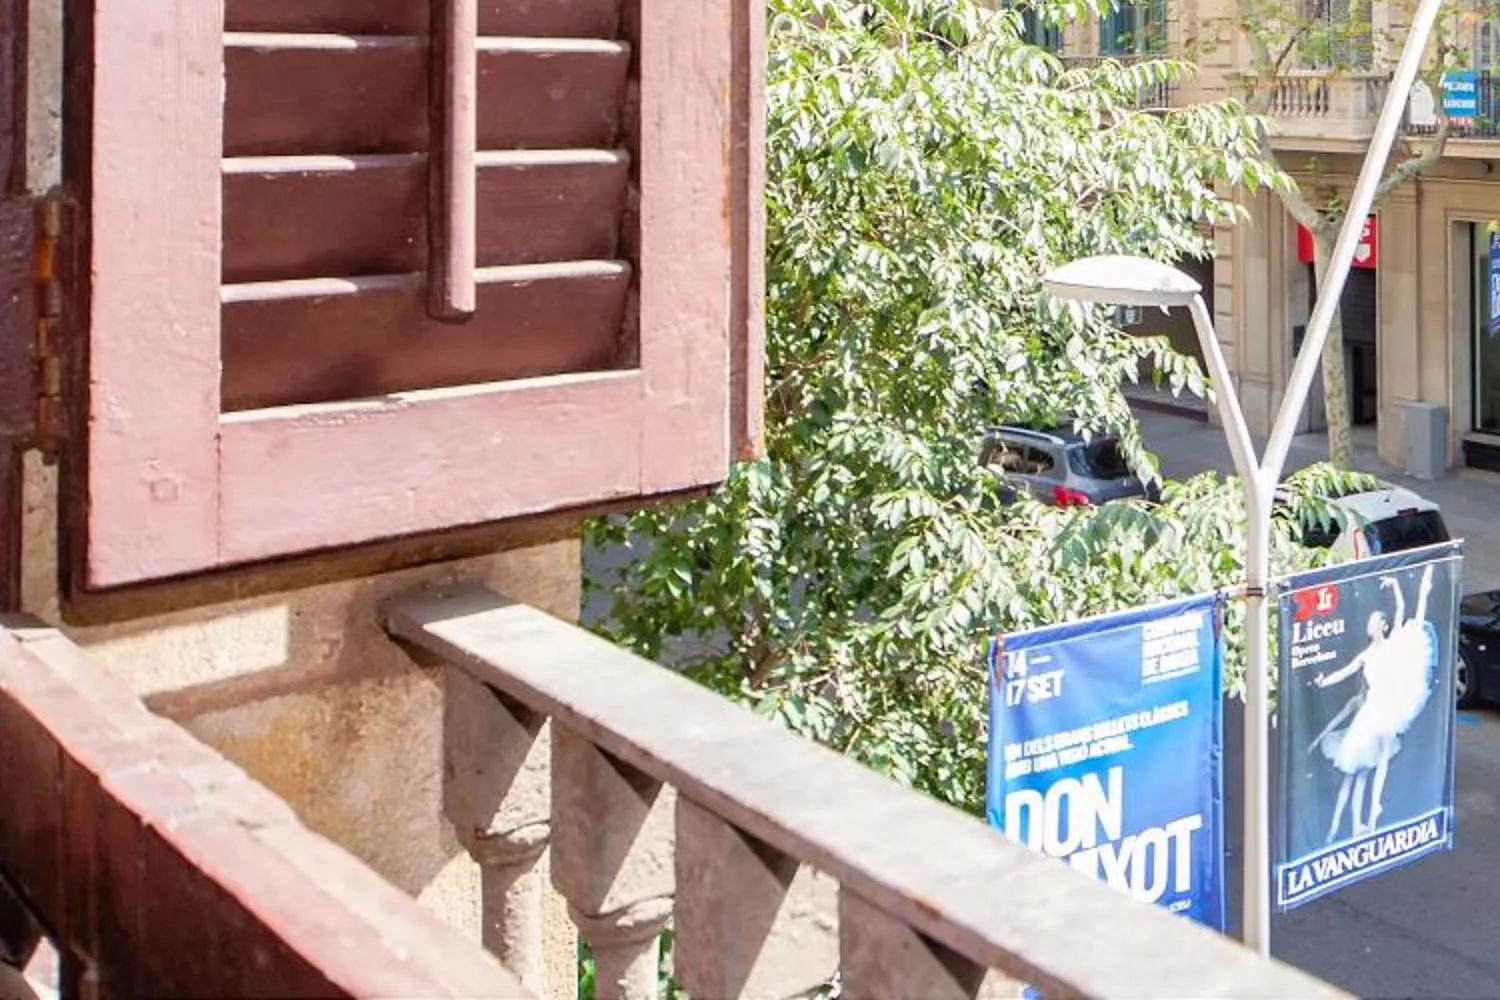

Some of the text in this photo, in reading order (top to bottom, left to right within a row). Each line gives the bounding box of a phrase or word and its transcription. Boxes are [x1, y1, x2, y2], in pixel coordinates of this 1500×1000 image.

[1292, 619, 1345, 644] Liceu
[1004, 650, 1027, 679] 14
[1006, 669, 1065, 707] 17 SET
[1005, 765, 1123, 858] DON
[1287, 817, 1439, 895] LA VANGUARDIA
